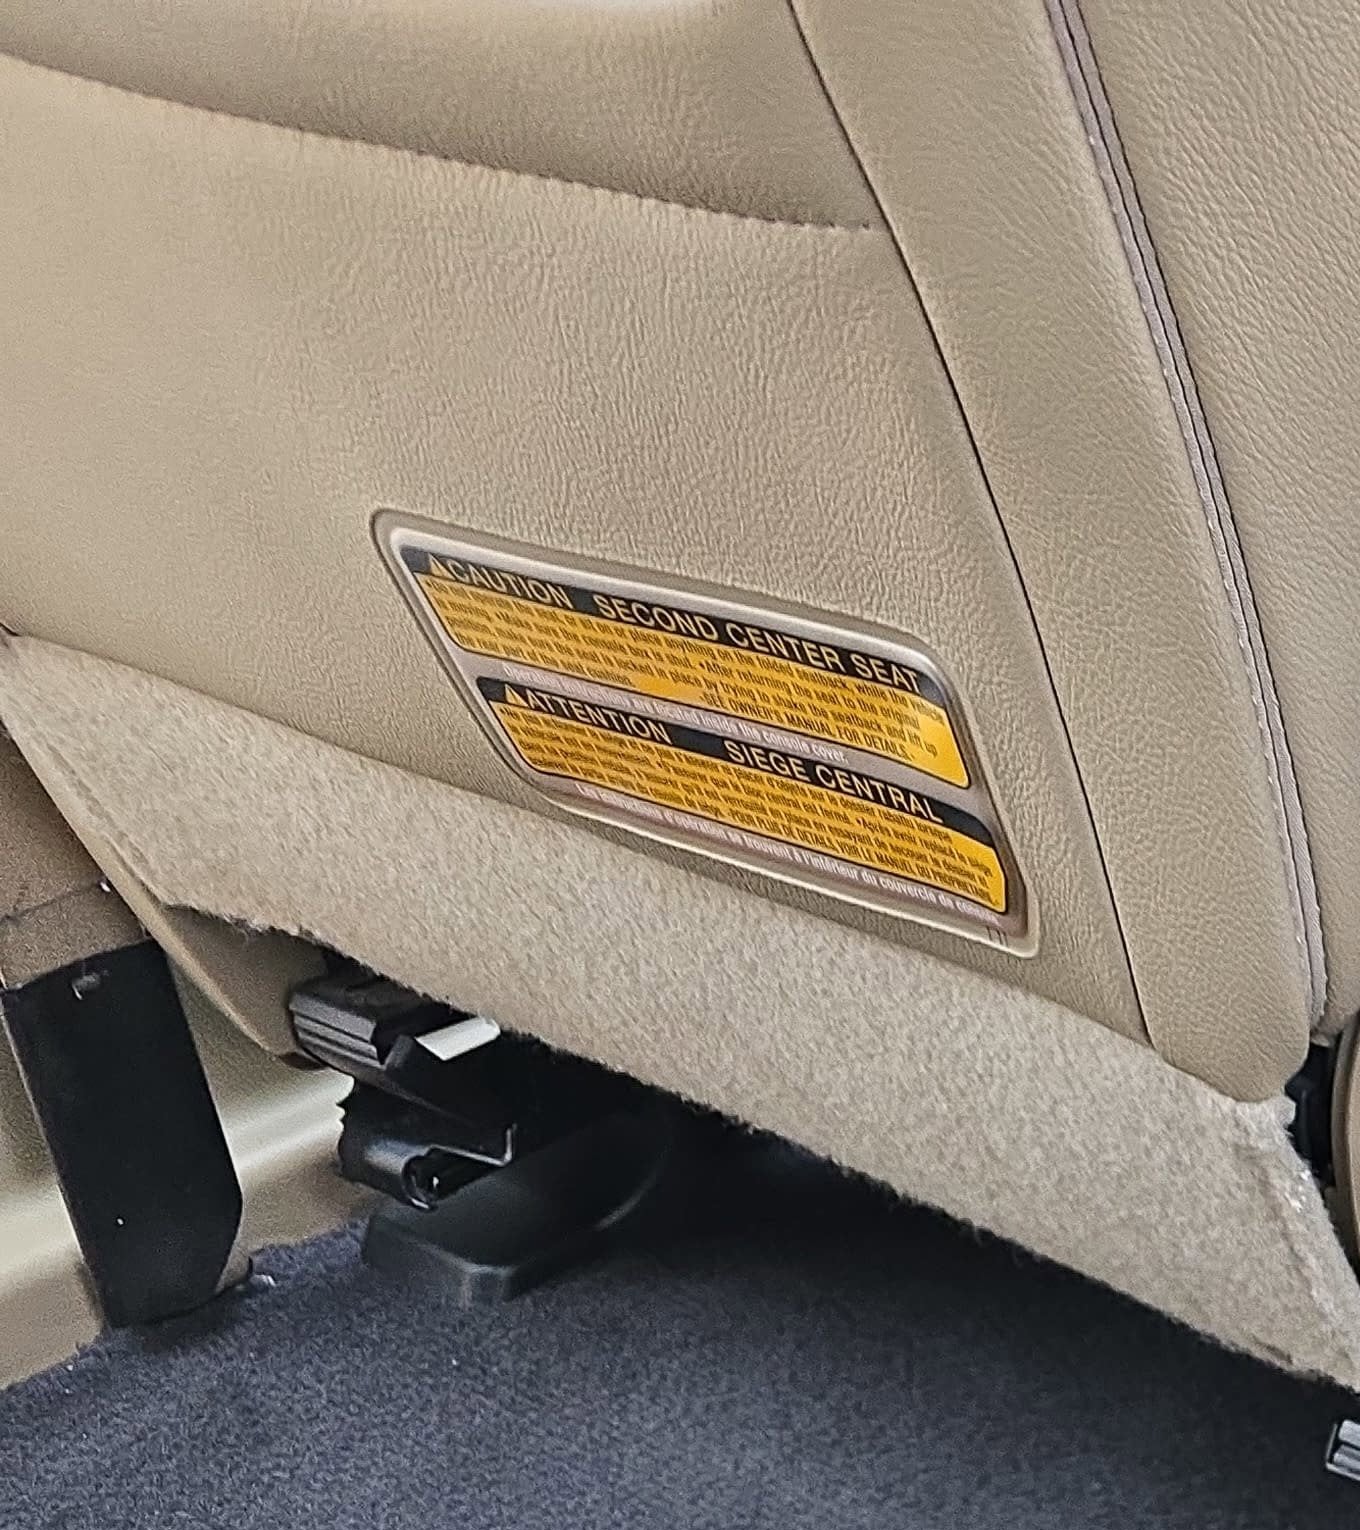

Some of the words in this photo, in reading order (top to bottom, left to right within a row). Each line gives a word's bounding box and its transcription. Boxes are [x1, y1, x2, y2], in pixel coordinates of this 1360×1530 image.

[447, 560, 573, 608] CAUTION
[593, 595, 717, 641] SECOND
[726, 623, 847, 673] CENTER
[850, 653, 921, 692] SEAT
[598, 624, 612, 634] on
[630, 629, 661, 645] place
[665, 638, 716, 661] anything
[718, 650, 732, 660] on
[733, 651, 754, 665] the
[756, 657, 793, 675] folded
[856, 684, 887, 699] while
[887, 690, 907, 705] the
[538, 653, 560, 667] the
[728, 697, 783, 723] OWNER'S
[785, 712, 832, 736] MANUAL
[836, 725, 861, 744] FOR
[863, 733, 915, 761] DETAILS.
[552, 641, 574, 656] the
[576, 650, 601, 663] seat
[612, 655, 654, 675] locked
[654, 665, 667, 678] in
[669, 669, 702, 686] place
[702, 676, 720, 695] by
[718, 679, 756, 702] trying
[755, 688, 769, 702] to
[772, 693, 806, 712] shake
[806, 700, 828, 719] the
[831, 710, 883, 733] seatback
[886, 726, 906, 741] and
[557, 626, 580, 642] the
[581, 635, 627, 654] console
[627, 642, 650, 659] box
[649, 647, 663, 662] is
[665, 652, 696, 669] shut.
[736, 669, 791, 695] returning
[790, 681, 811, 696] the
[814, 690, 841, 704] seat
[841, 694, 855, 708] to
[858, 698, 877, 714] the
[881, 708, 921, 729] original
[524, 689, 672, 745] ATTENTION
[724, 740, 810, 782] SIEGE
[816, 764, 944, 822] CENTRAL
[738, 722, 761, 740] the
[763, 732, 808, 753] console
[812, 745, 848, 763] cover.
[862, 870, 876, 885] du
[880, 879, 935, 903] couvercle
